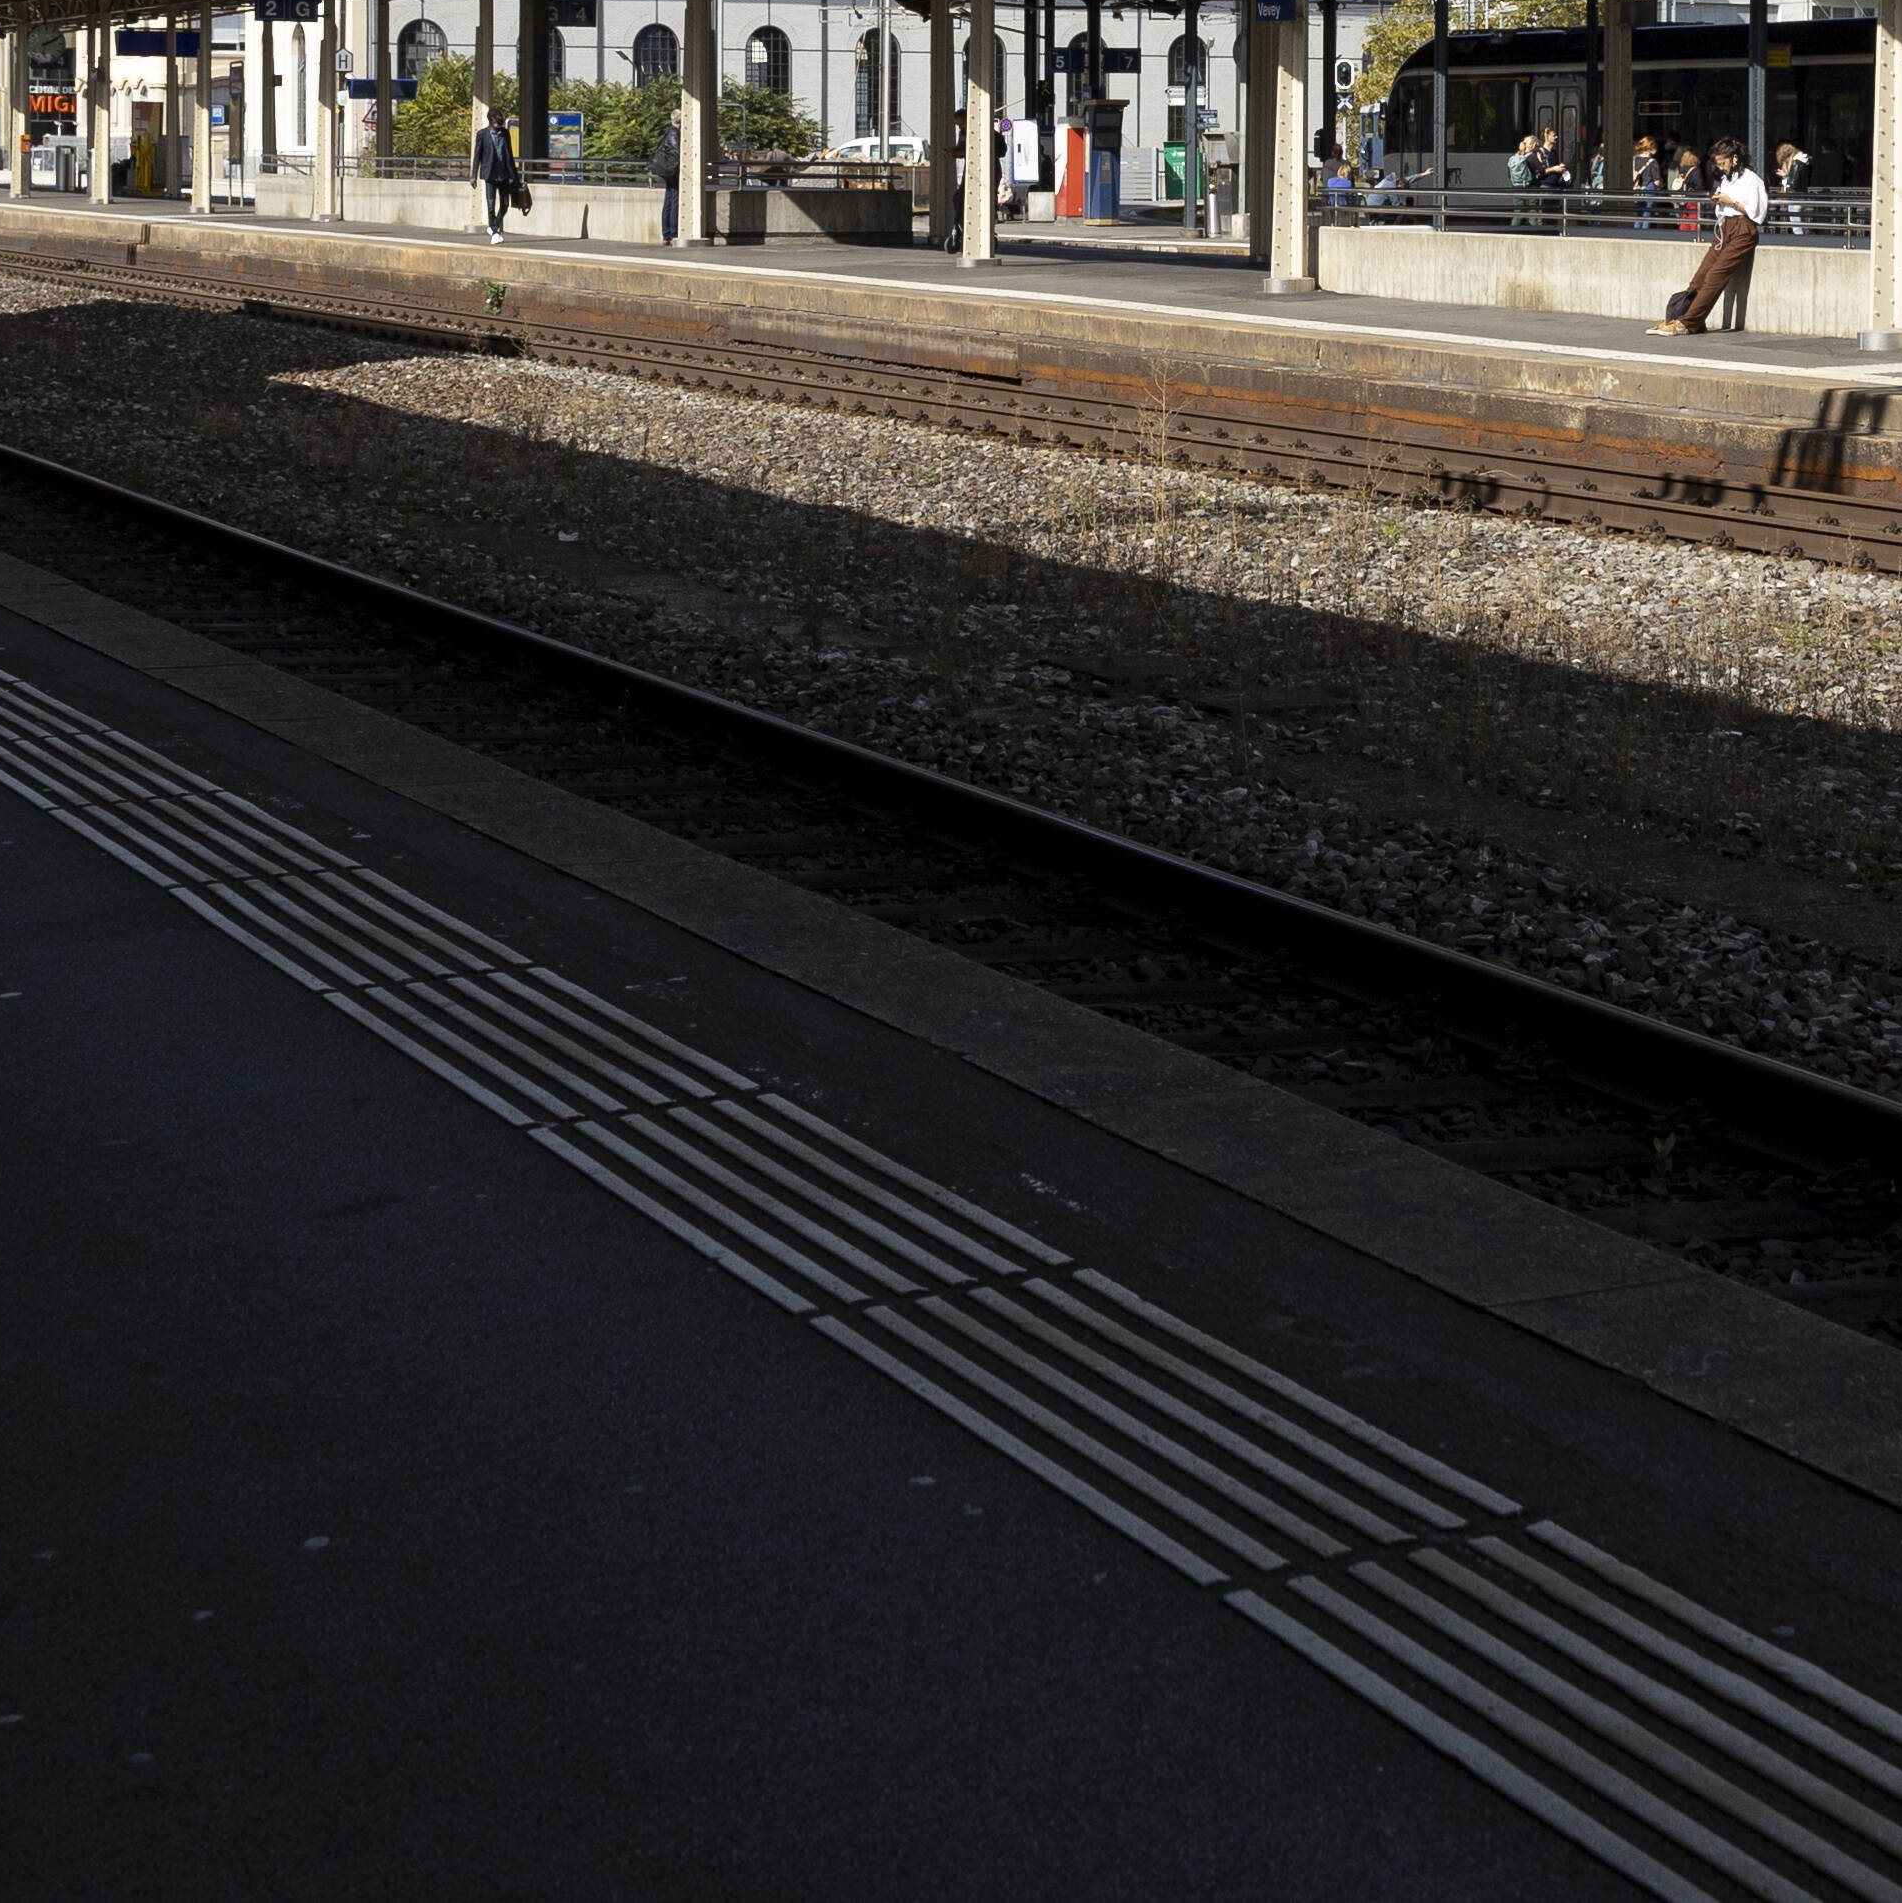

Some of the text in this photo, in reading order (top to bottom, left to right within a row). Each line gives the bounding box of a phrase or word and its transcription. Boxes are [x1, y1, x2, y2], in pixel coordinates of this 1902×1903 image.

[265, 0, 277, 17] 2
[295, 1, 310, 18] G
[576, 6, 587, 22] 4
[1257, 2, 1281, 20] Vevey
[338, 54, 348, 69] H
[1055, 55, 1065, 69] 5
[1123, 56, 1134, 69] 7
